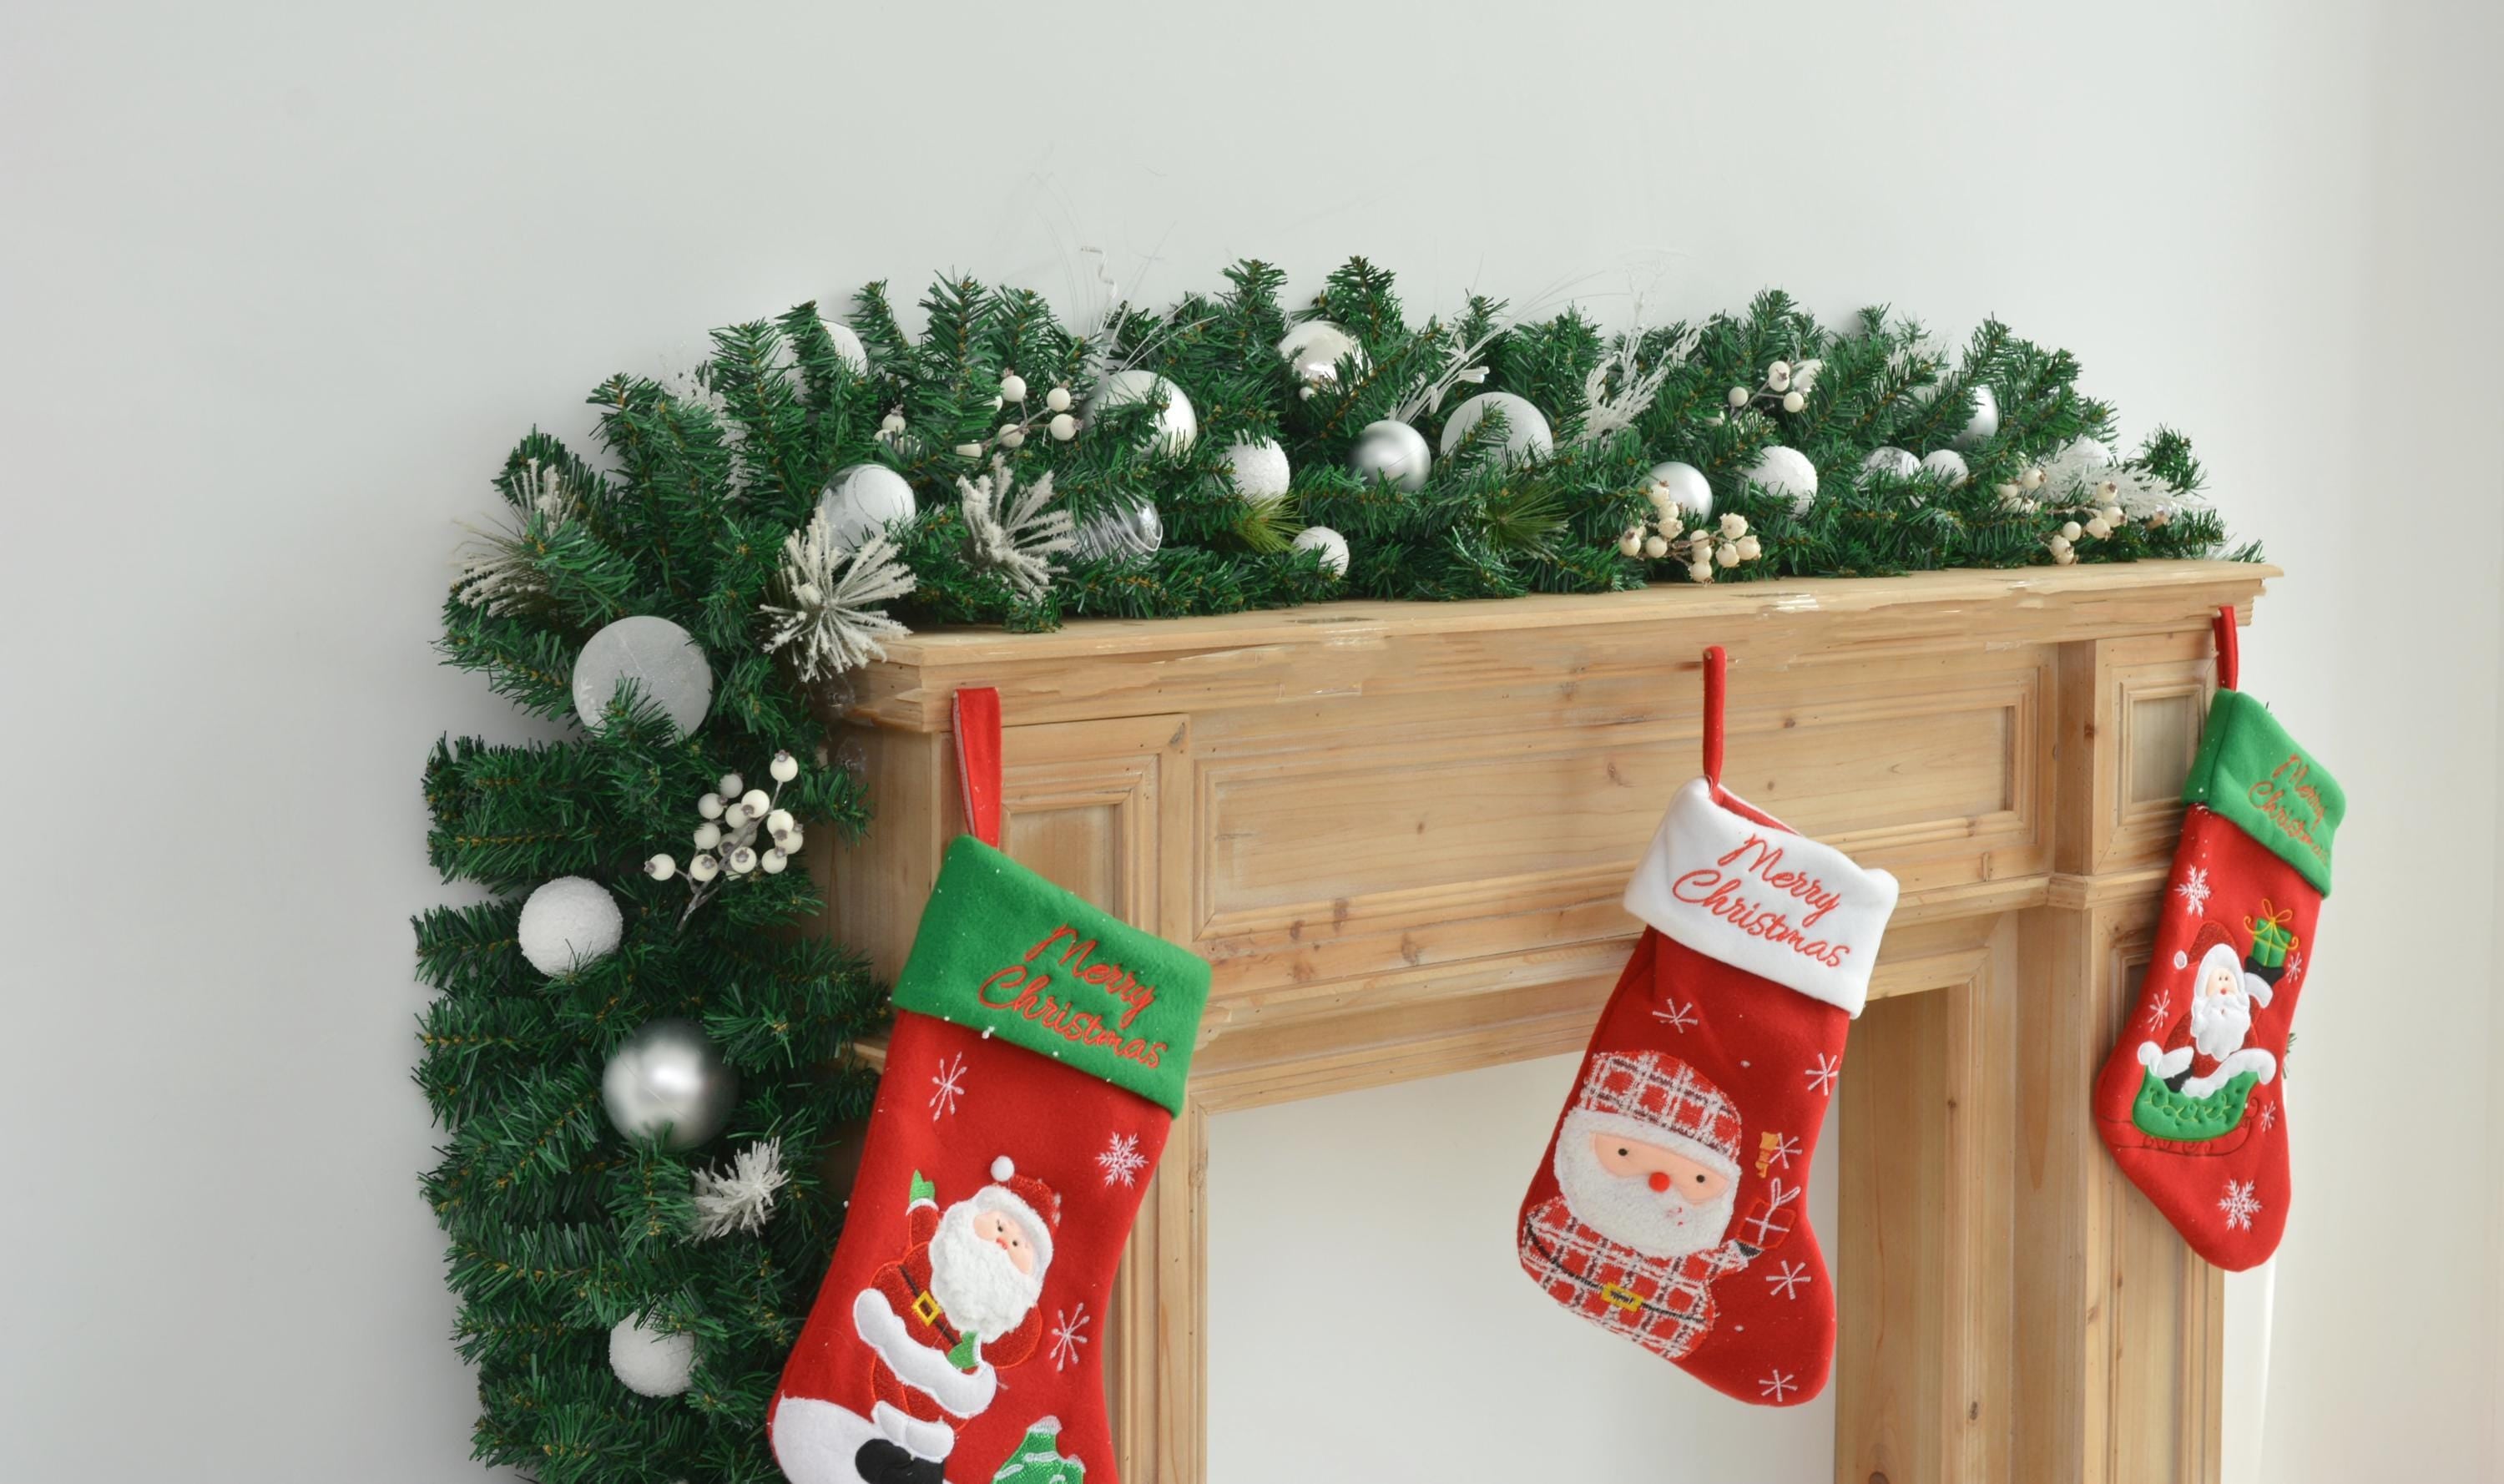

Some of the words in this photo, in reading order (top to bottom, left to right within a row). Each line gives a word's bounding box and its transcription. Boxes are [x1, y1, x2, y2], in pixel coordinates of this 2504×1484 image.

[2271, 754, 2325, 832] Merry
[1672, 869, 1850, 967] Christmas
[1717, 834, 1840, 928] Merry
[977, 965, 1168, 1069] Christmas
[1024, 923, 1156, 1029] Merry
